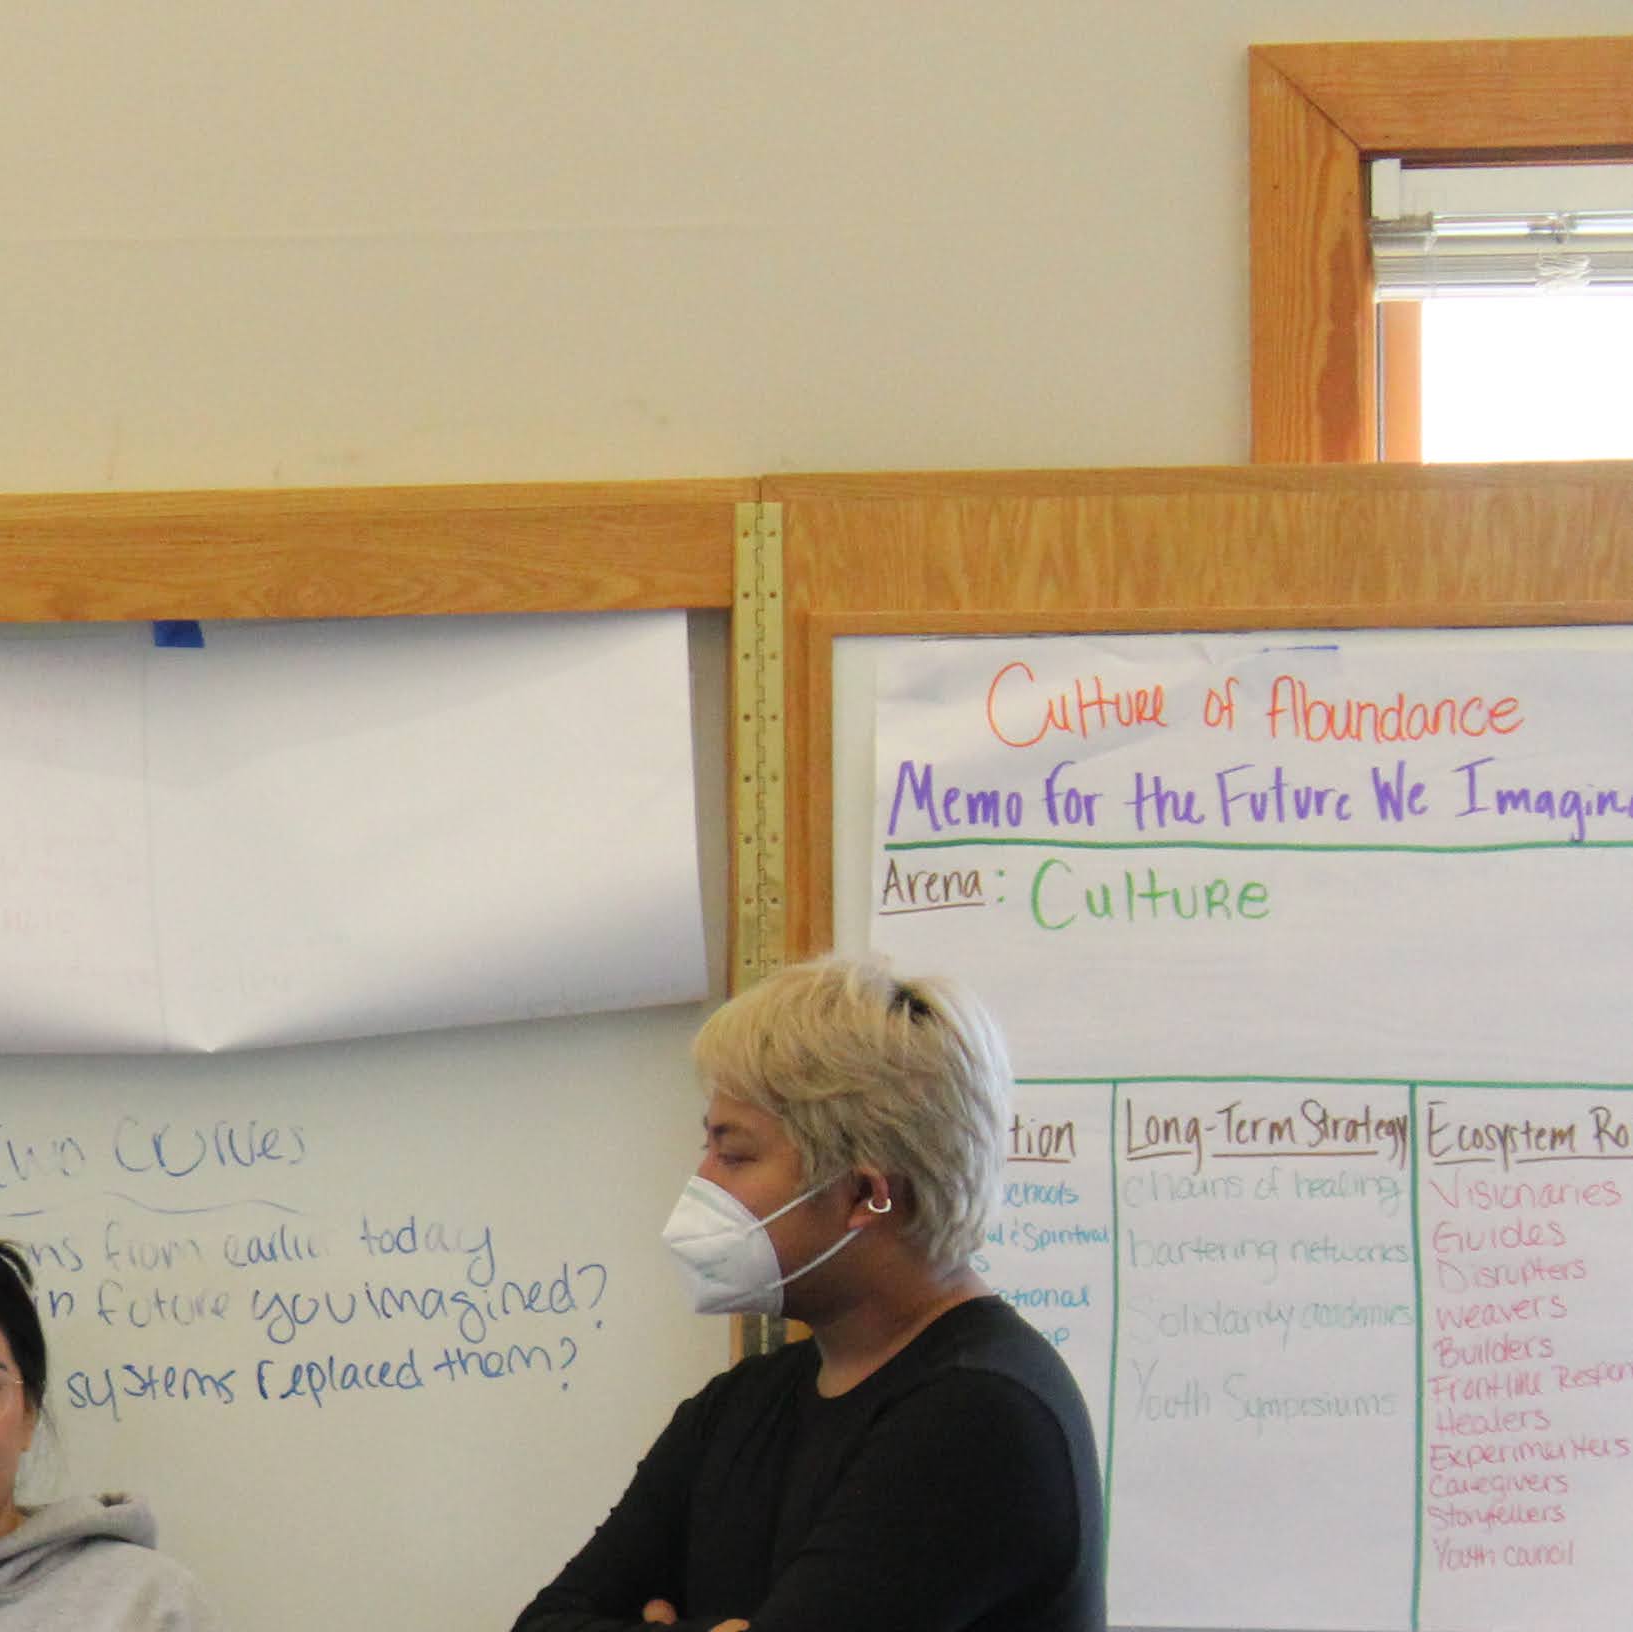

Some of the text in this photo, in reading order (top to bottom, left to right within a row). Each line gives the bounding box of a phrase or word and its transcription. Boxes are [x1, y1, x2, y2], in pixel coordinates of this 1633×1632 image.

[1202, 676, 1239, 732] of
[1267, 674, 1525, 743] Abundance
[886, 759, 1024, 837] Memo
[1042, 760, 1104, 827] for
[1125, 771, 1205, 832] the
[1215, 762, 1352, 828] Future
[1371, 760, 1428, 822] We
[1126, 1097, 1409, 1176] Long-Term Strategy
[1428, 1100, 1576, 1173] Ecosystem
[1429, 1168, 1623, 1211] Visionaries
[360, 1215, 496, 1288] today
[1433, 1216, 1567, 1254] Guides
[1435, 1256, 1587, 1294] Disrupters
[97, 1278, 231, 1328] future
[250, 1289, 357, 1344] you
[66, 1363, 237, 1423] systems
[256, 1347, 424, 1409] replaced
[433, 1336, 578, 1391] them?
[1433, 1332, 1554, 1369] Builders
[1436, 1406, 1551, 1437] Healers
[1428, 1473, 1568, 1503] Caregivers
